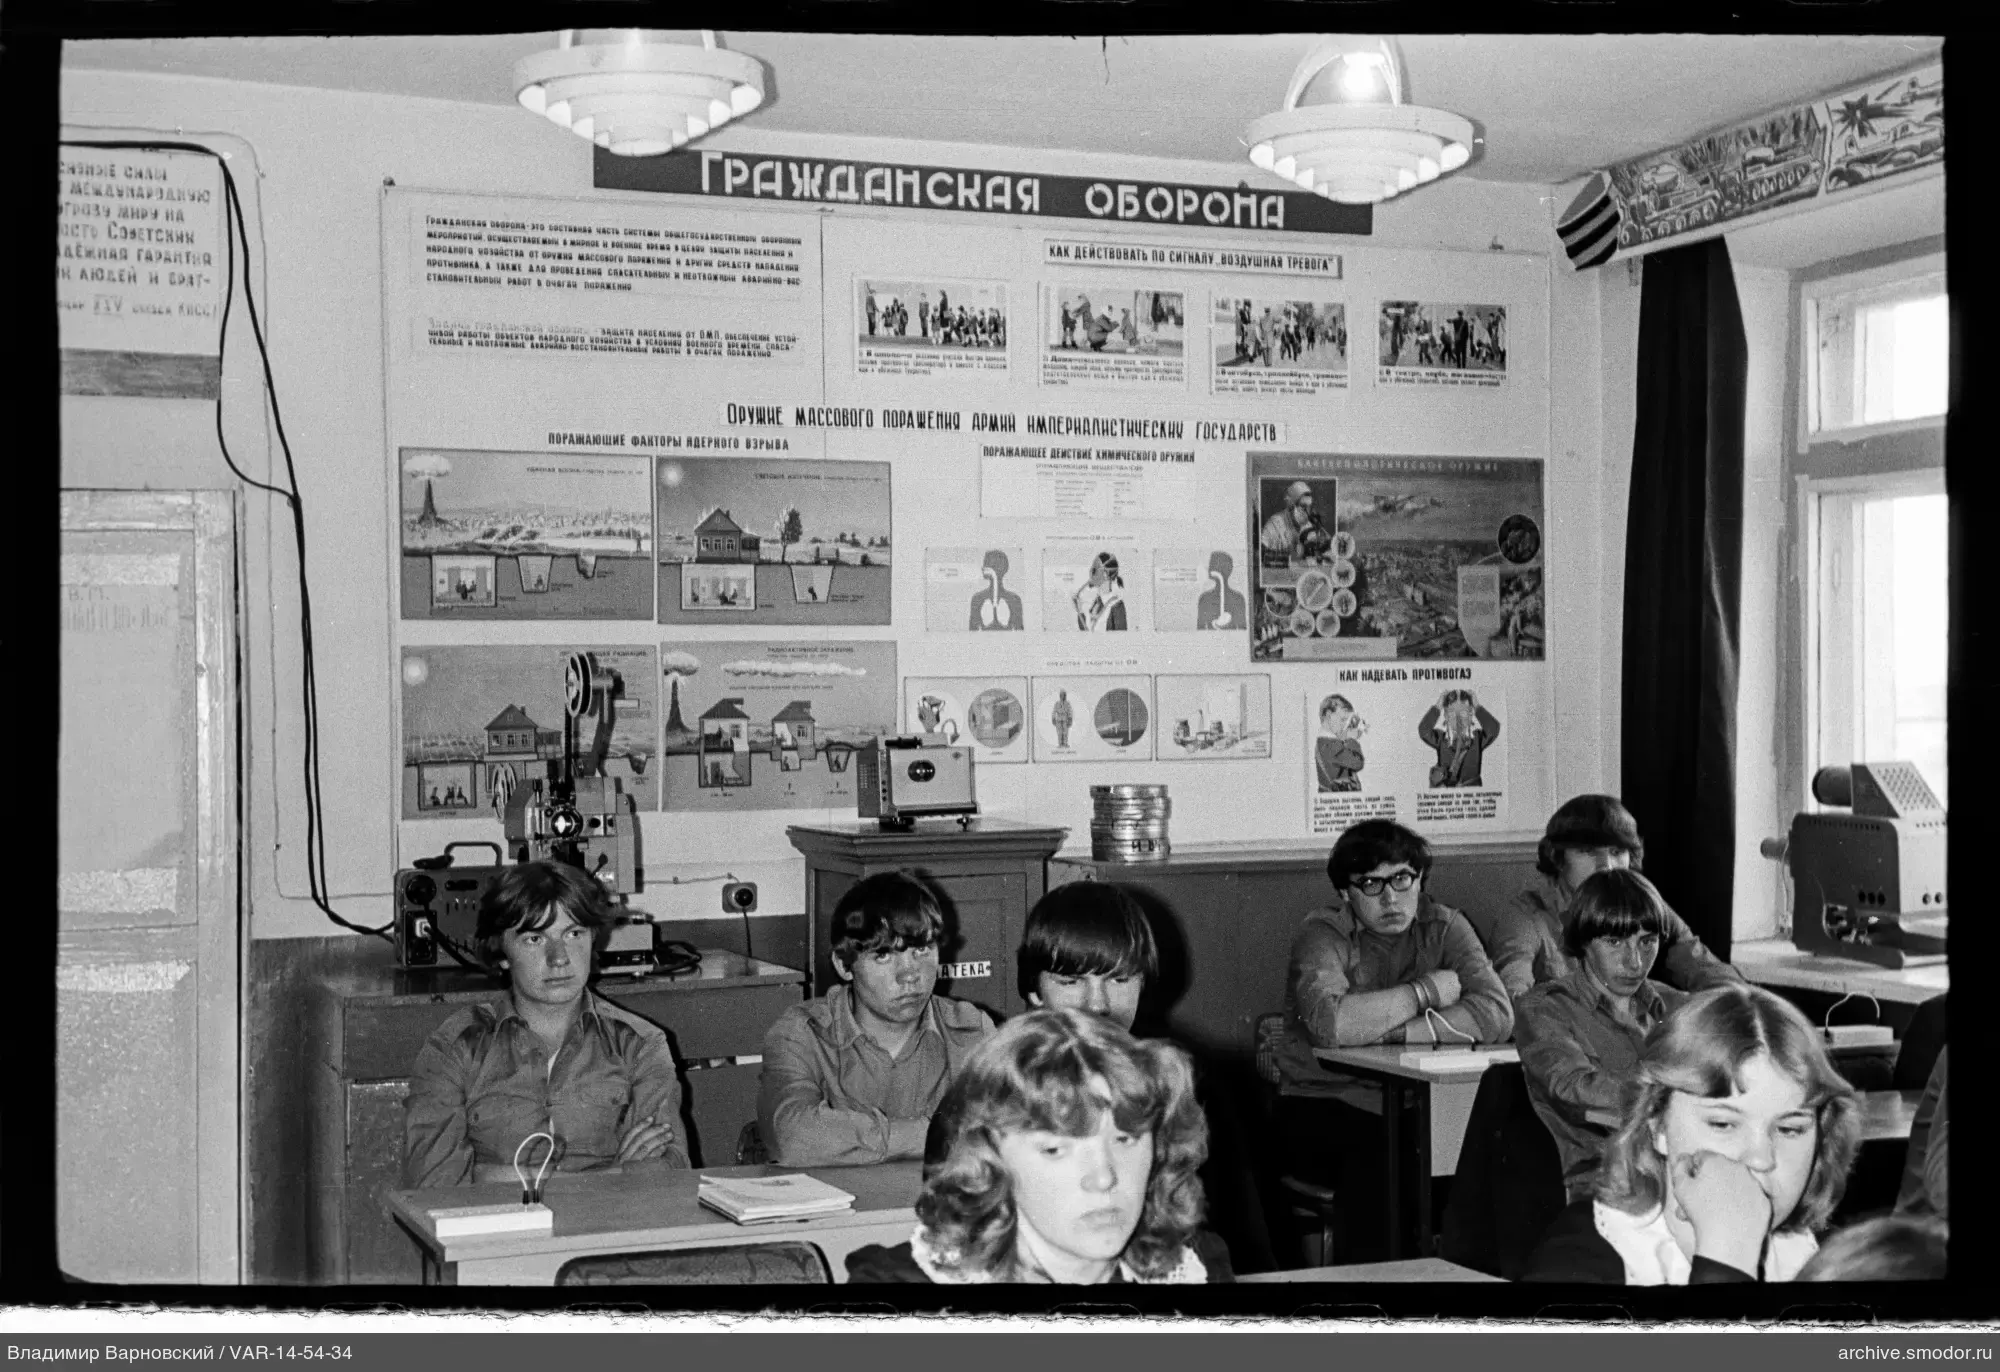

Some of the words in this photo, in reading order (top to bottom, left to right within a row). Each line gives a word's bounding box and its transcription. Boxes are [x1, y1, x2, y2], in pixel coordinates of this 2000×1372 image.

[124, 166, 168, 181] СИЛЫ
[69, 181, 211, 203] МЕЖДУНАРОДНУЮ
[701, 151, 1040, 212] ГРАЖДАНСКАЯ
[1085, 183, 1285, 229] ОБОРОНА
[118, 205, 159, 221] МИРУ
[165, 209, 185, 223] НА
[108, 221, 195, 244] СОВЕТСКИХ
[426, 215, 487, 228] ГРАЖДАНСКАЯ
[548, 223, 592, 234] СОСТАВНАЯ
[596, 226, 620, 235] ЧАСТЬ
[624, 227, 660, 237] СИСТЕМЫ
[137, 248, 212, 266] ГАРАНТИЯ
[426, 244, 474, 255] НАРОДНОГО
[478, 247, 524, 258] ХОЗЯЙСТВА
[528, 250, 539, 259] ОТ
[542, 250, 573, 260] ОРУЖИЯ
[578, 252, 624, 263] МАССОВОГО
[627, 255, 671, 265] ПОРАЖЕНИЯ
[676, 257, 681, 266] И
[686, 258, 714, 268] ДРУГИХ
[718, 259, 750, 269] СРЕДСТВ
[755, 261, 800, 272] НАПАДЕНИЯ
[1049, 245, 1070, 258] КАК
[1074, 243, 1148, 262] ДЕЙСТВОВАТЬ
[1152, 250, 1165, 262] ПО
[1169, 250, 1214, 265] СИГНАЛУ
[80, 266, 138, 285] ЛЮДЕЙ
[426, 274, 502, 285] СТАНОВИТЕЛЬНЫХ
[507, 277, 532, 287] РАБОТ
[537, 279, 542, 287] В
[546, 279, 577, 289] ОЧАГАХ
[486, 262, 490, 270] А
[496, 262, 522, 272] ТАКЖЕ
[528, 264, 546, 273] ДЛЯ
[550, 265, 602, 276] ПРОВЕДЕНИЯ
[608, 268, 670, 280] СПАСАТЕЛЬНЫХ
[674, 272, 680, 280] И
[683, 272, 736, 283] НЕОТЛОЖНЫХ
[727, 403, 783, 426] ОРУЖИЕ
[795, 405, 874, 428] МАССОВОГО
[883, 409, 960, 431] ПОРАЖЕНИЯ
[972, 411, 1016, 433] АРМИЙ
[1027, 414, 1184, 439] ИМПЕРИАЛИСТИЧЕСКИХ
[1196, 421, 1277, 442] ГОСУДАРСТВ
[548, 433, 625, 447] ПОРАЖАЮЩИЕ
[631, 435, 682, 448] ФАКТОРЫ
[686, 436, 739, 450] ЯДЕРНОГО
[745, 437, 789, 451] ВЗРЫВА
[983, 445, 1047, 459] ПОРАЖАЮЩЕЕ
[1050, 447, 1092, 460] ДЕЙСТВИЕ
[1095, 448, 1157, 462] ХИМИЧЕСКОГО
[1160, 451, 1195, 463] ОРУЖИЯ
[1339, 669, 1357, 682] КАК
[1361, 668, 1408, 683] НАДЕВАТЬ
[1412, 668, 1472, 681] ПРОТИВОГАЗ
[941, 963, 984, 977] АТЕКА
